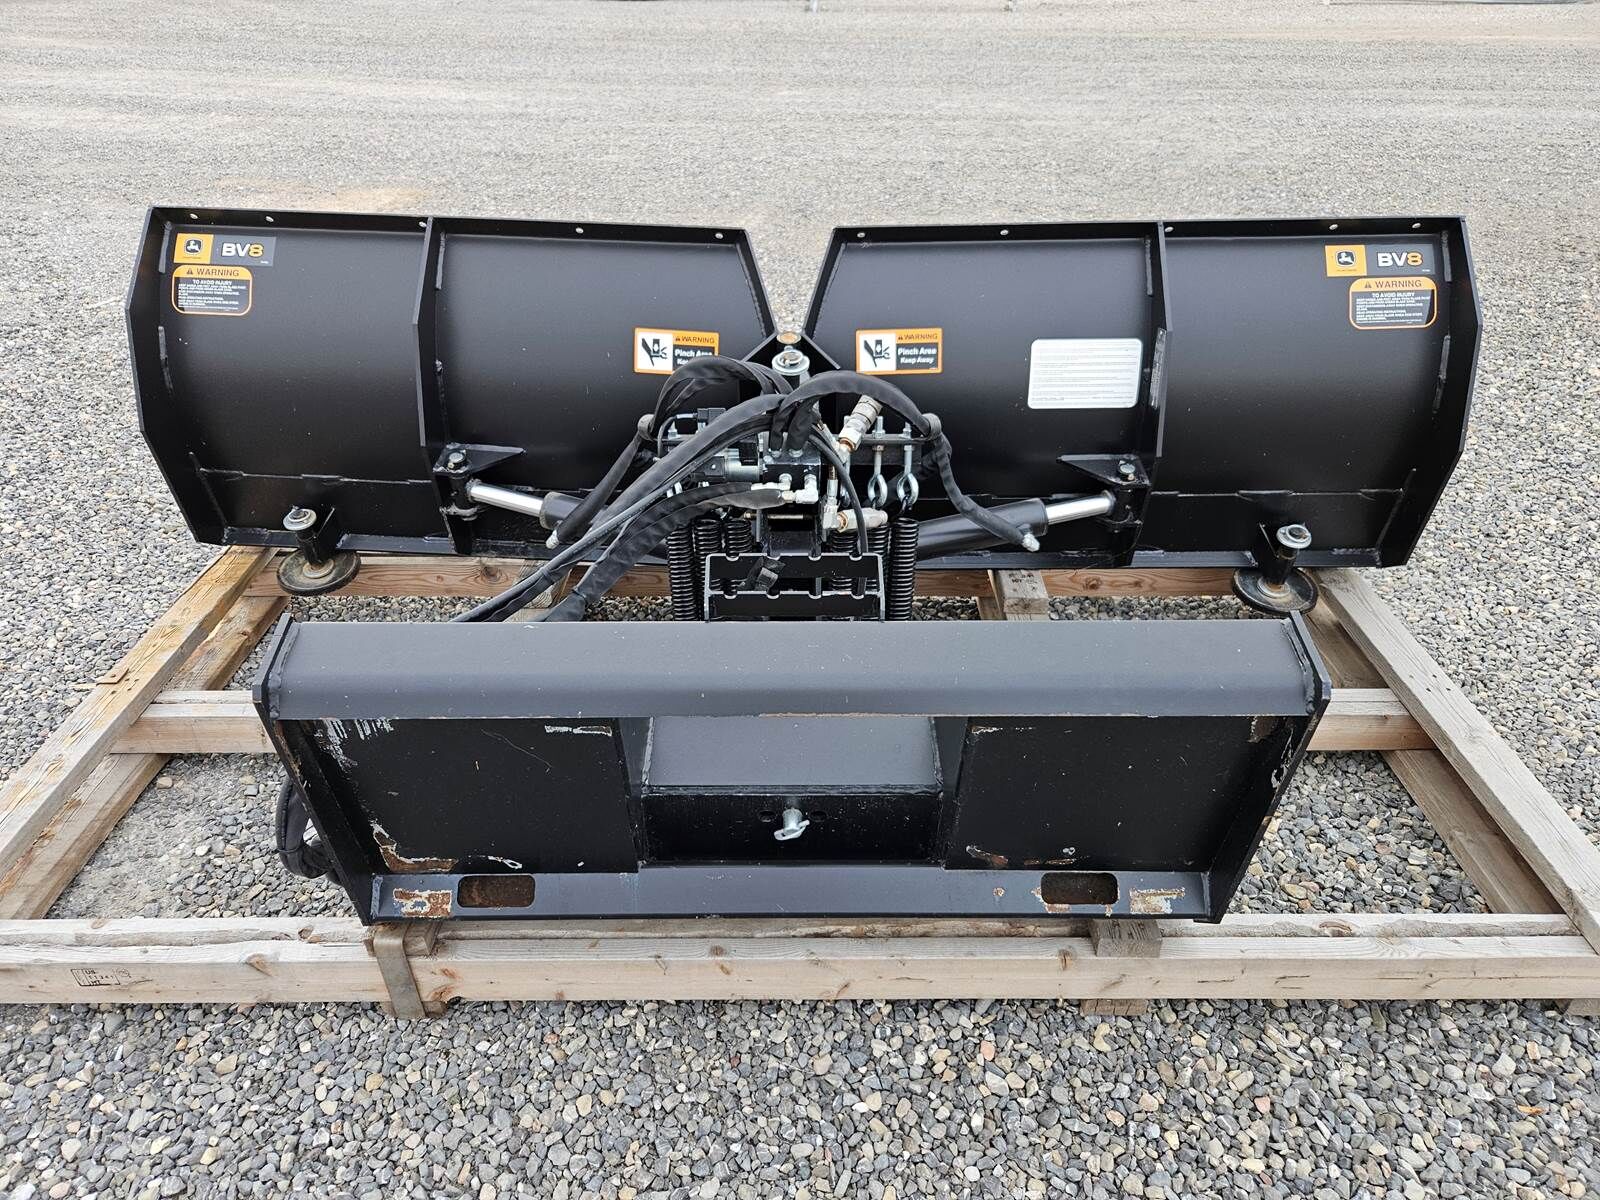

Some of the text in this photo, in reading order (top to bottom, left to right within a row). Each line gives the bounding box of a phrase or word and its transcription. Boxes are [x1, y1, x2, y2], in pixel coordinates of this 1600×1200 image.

[222, 242, 264, 257] BV8
[1377, 251, 1423, 267] BV8
[196, 268, 240, 276] WARNING
[1375, 280, 1422, 288] WARNING
[675, 349, 695, 357] Pinch
[898, 347, 918, 355] Pinch
